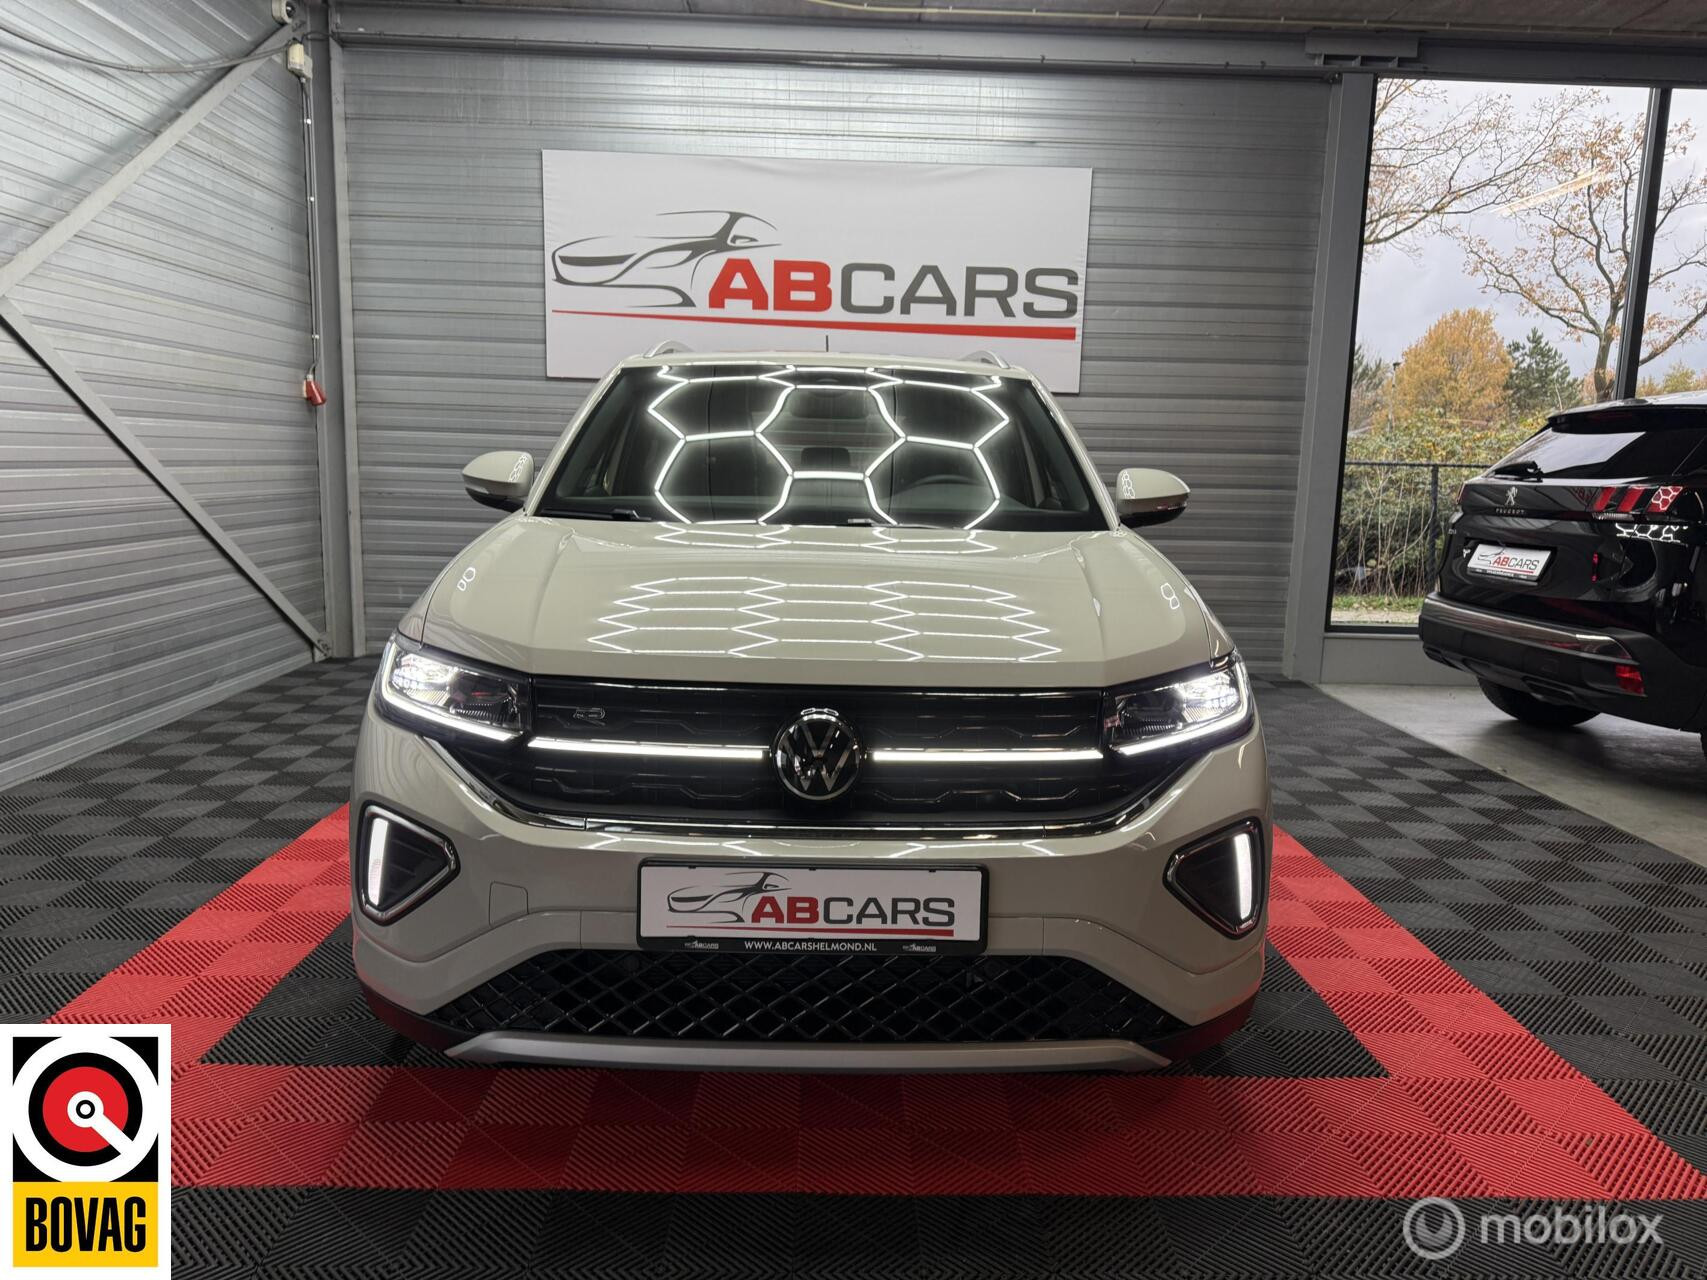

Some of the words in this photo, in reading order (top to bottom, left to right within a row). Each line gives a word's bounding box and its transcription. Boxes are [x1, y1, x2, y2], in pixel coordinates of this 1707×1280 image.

[708, 257, 1078, 320] ABCARS
[1492, 556, 1540, 571] ABCARS
[751, 895, 955, 927] ABCARS
[744, 940, 878, 952] WWW.ABCARSHELMOND.NL
